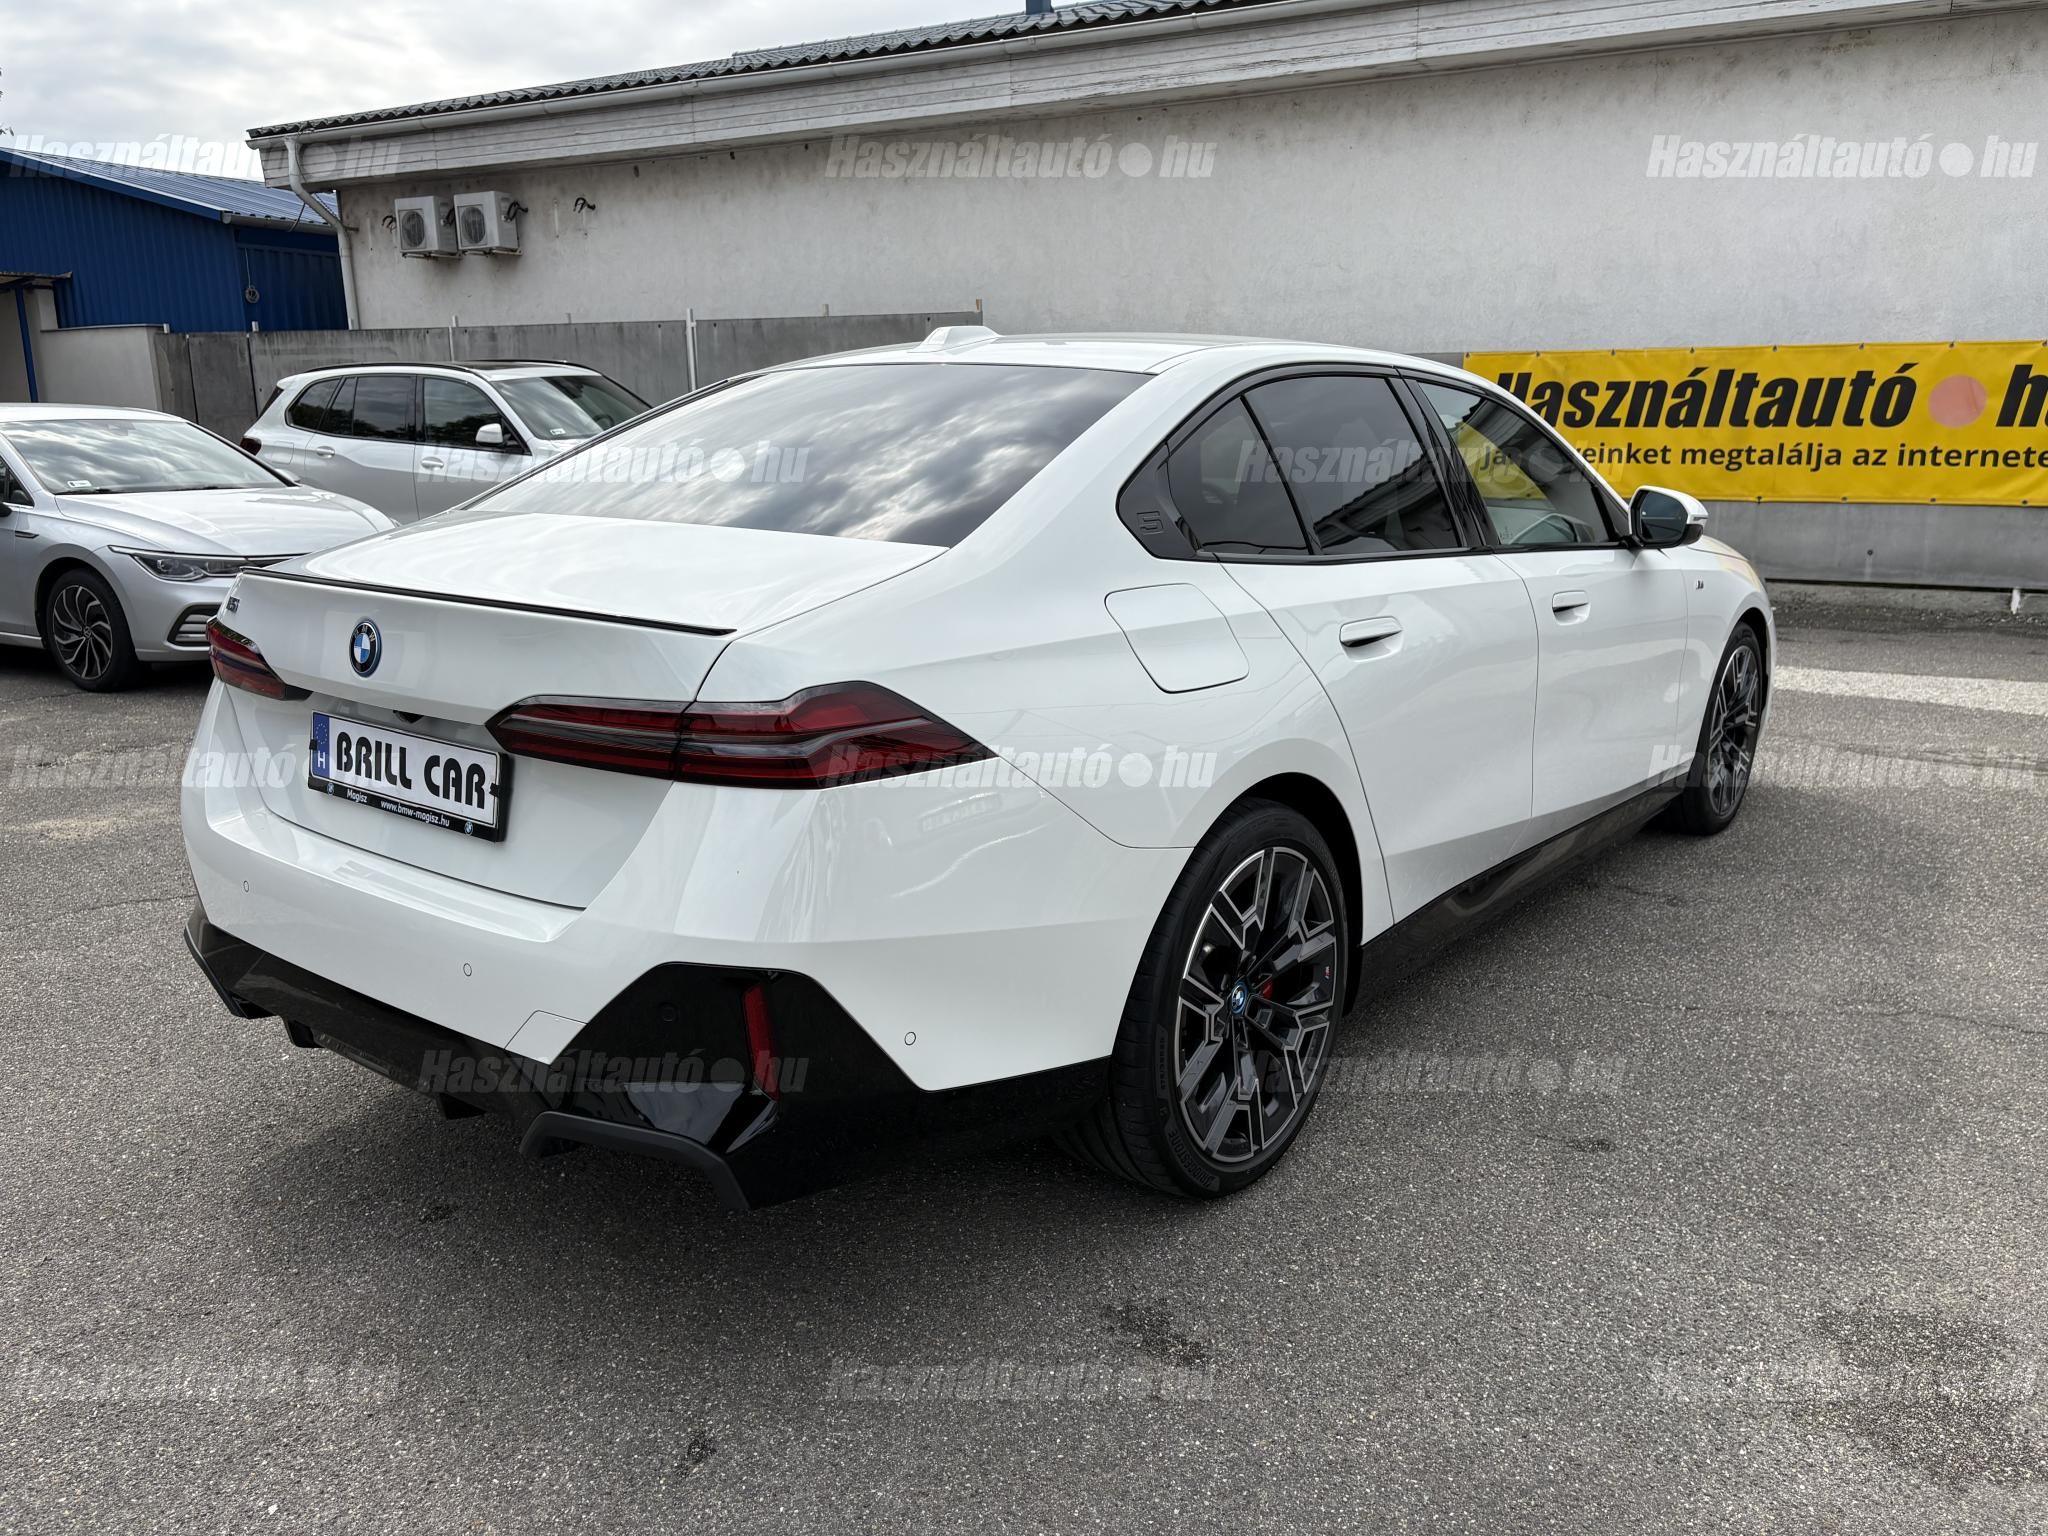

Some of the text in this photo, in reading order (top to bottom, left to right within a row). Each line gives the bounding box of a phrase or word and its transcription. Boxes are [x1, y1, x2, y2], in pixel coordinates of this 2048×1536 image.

[1996, 364, 2048, 428] h
[1681, 443, 1842, 472] megtalálja
[1852, 448, 1888, 466] az
[317, 751, 326, 769] H
[336, 731, 486, 809] BRILL CAR
[346, 788, 368, 803] Magisz
[380, 800, 450, 827] www.bmw-magisz.hu
